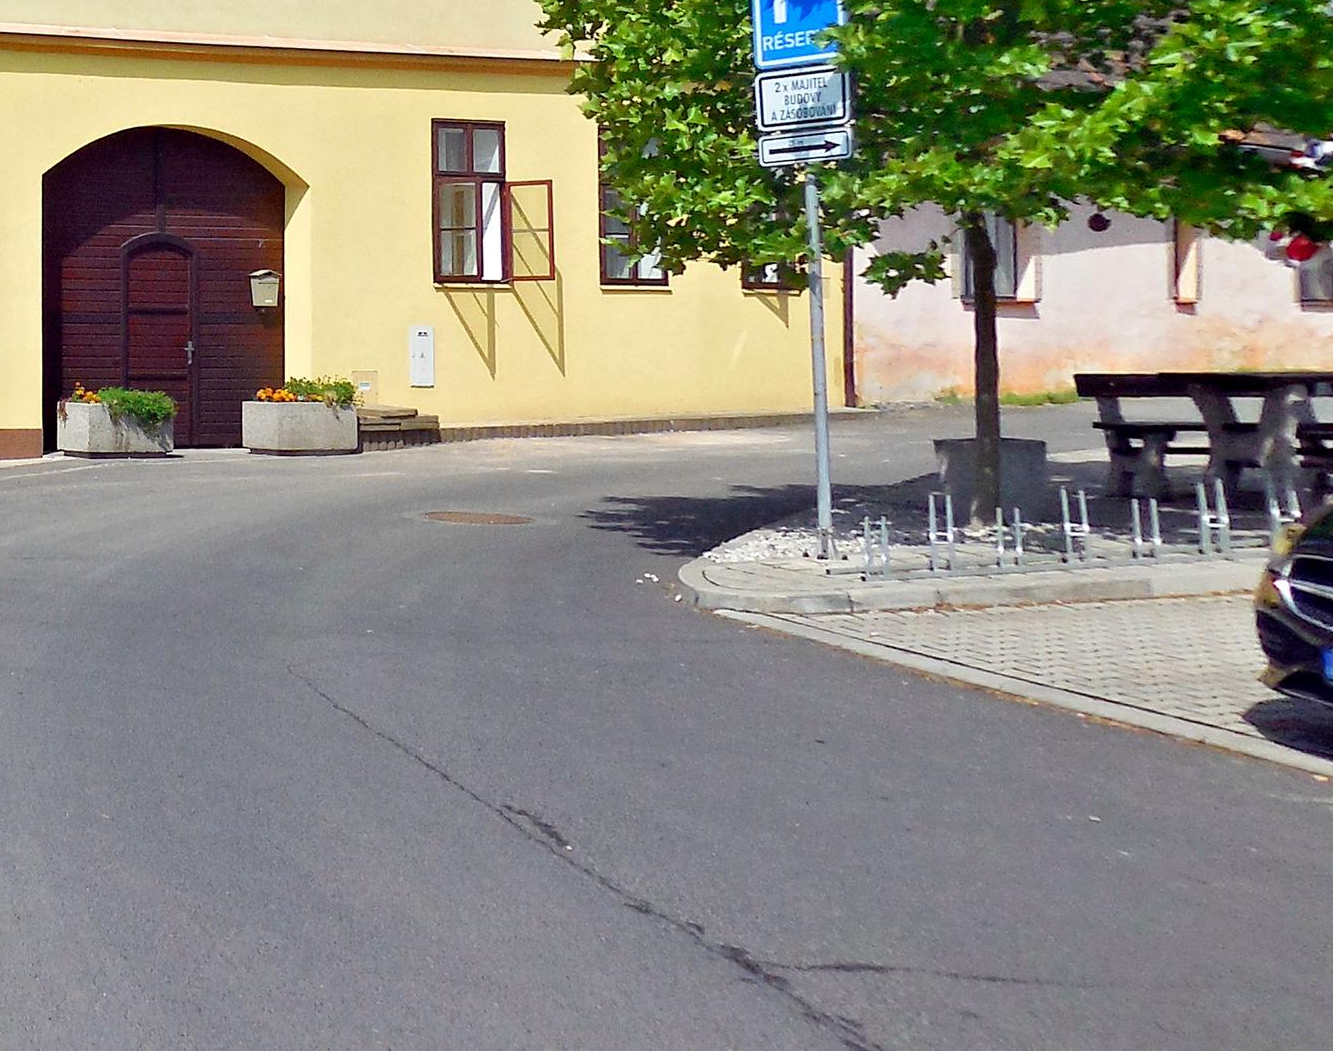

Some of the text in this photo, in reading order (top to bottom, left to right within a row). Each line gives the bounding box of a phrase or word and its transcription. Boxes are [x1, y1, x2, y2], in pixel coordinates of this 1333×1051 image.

[774, 82, 781, 93] 2
[791, 77, 828, 91] MAJITEL
[784, 92, 821, 105] BUDOVY
[771, 111, 777, 121] A
